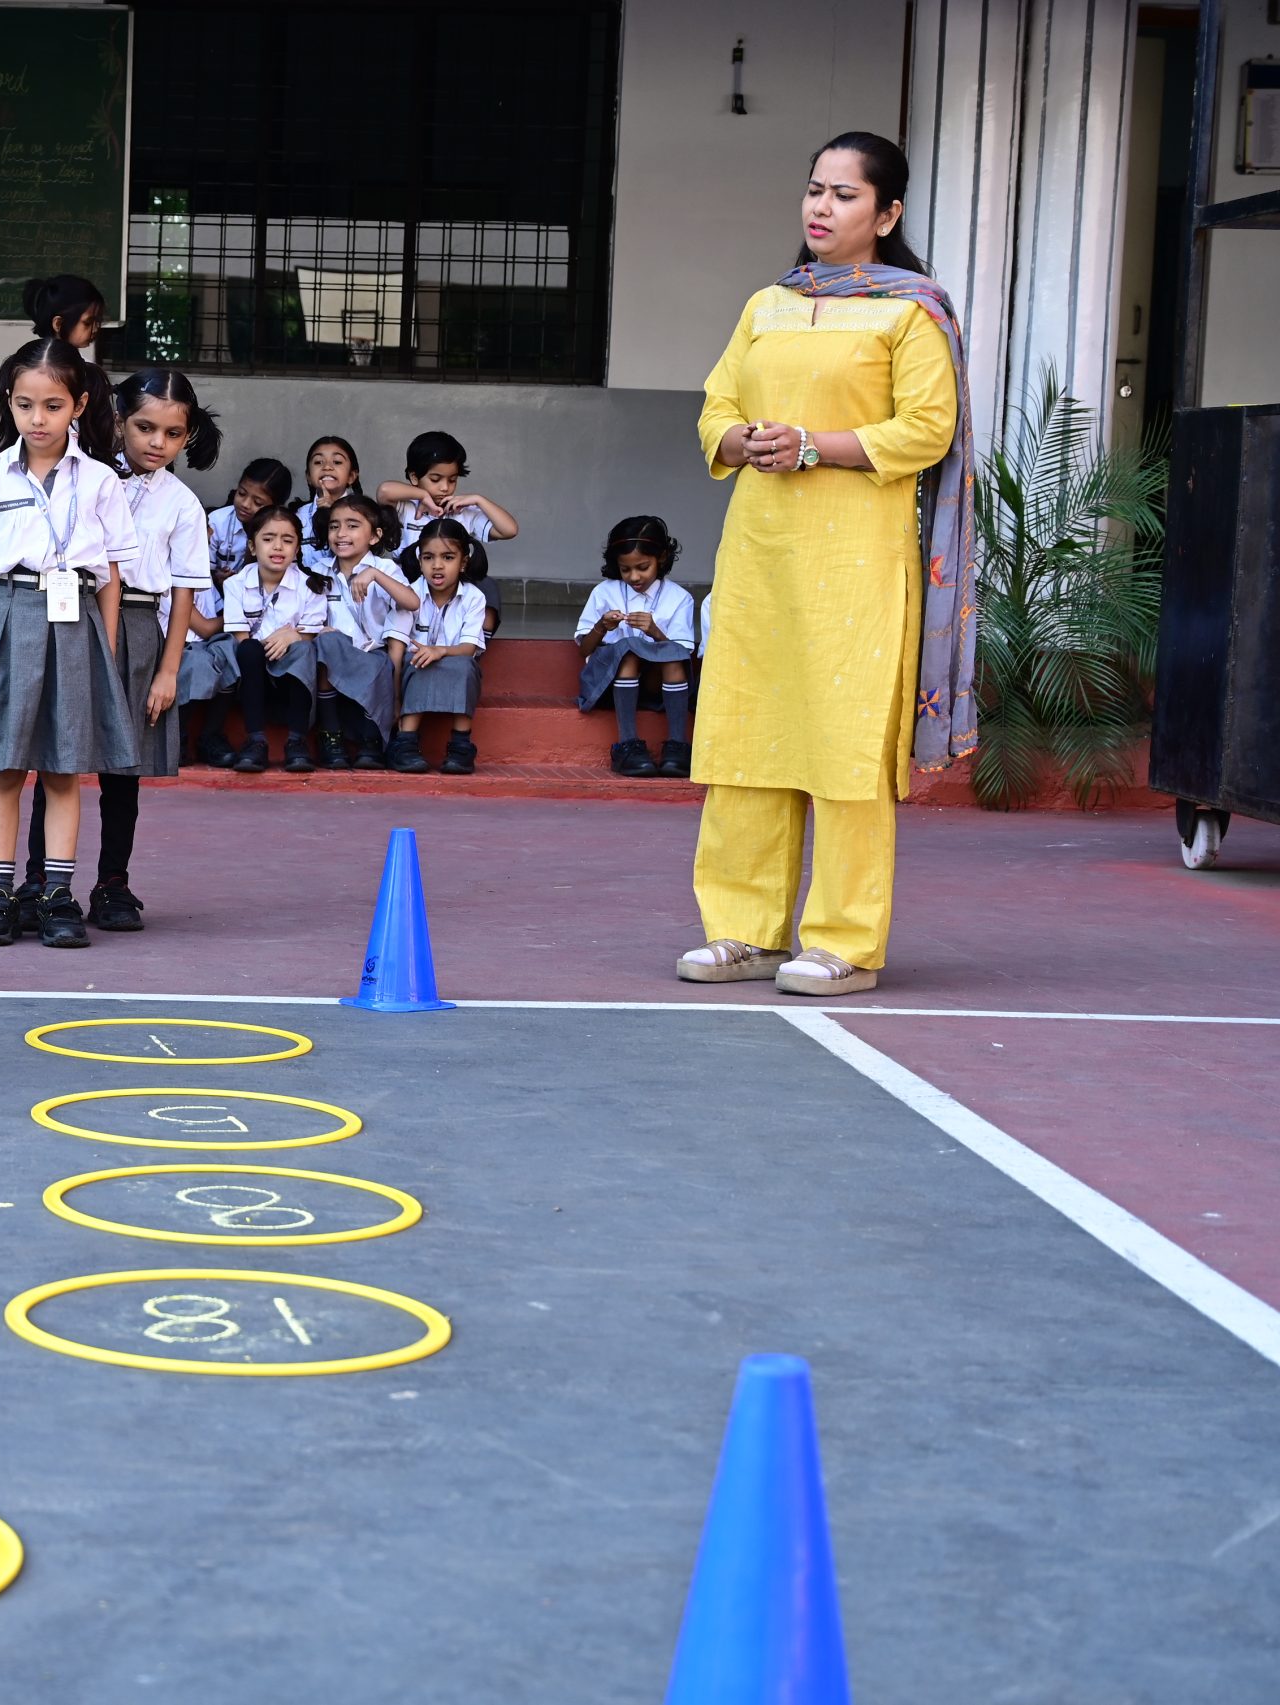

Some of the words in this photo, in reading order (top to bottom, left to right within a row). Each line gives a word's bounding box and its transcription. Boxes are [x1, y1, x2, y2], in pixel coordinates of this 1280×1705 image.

[148, 1106, 249, 1132] 5
[175, 1185, 315, 1230] 8
[143, 1295, 312, 1345] 18
